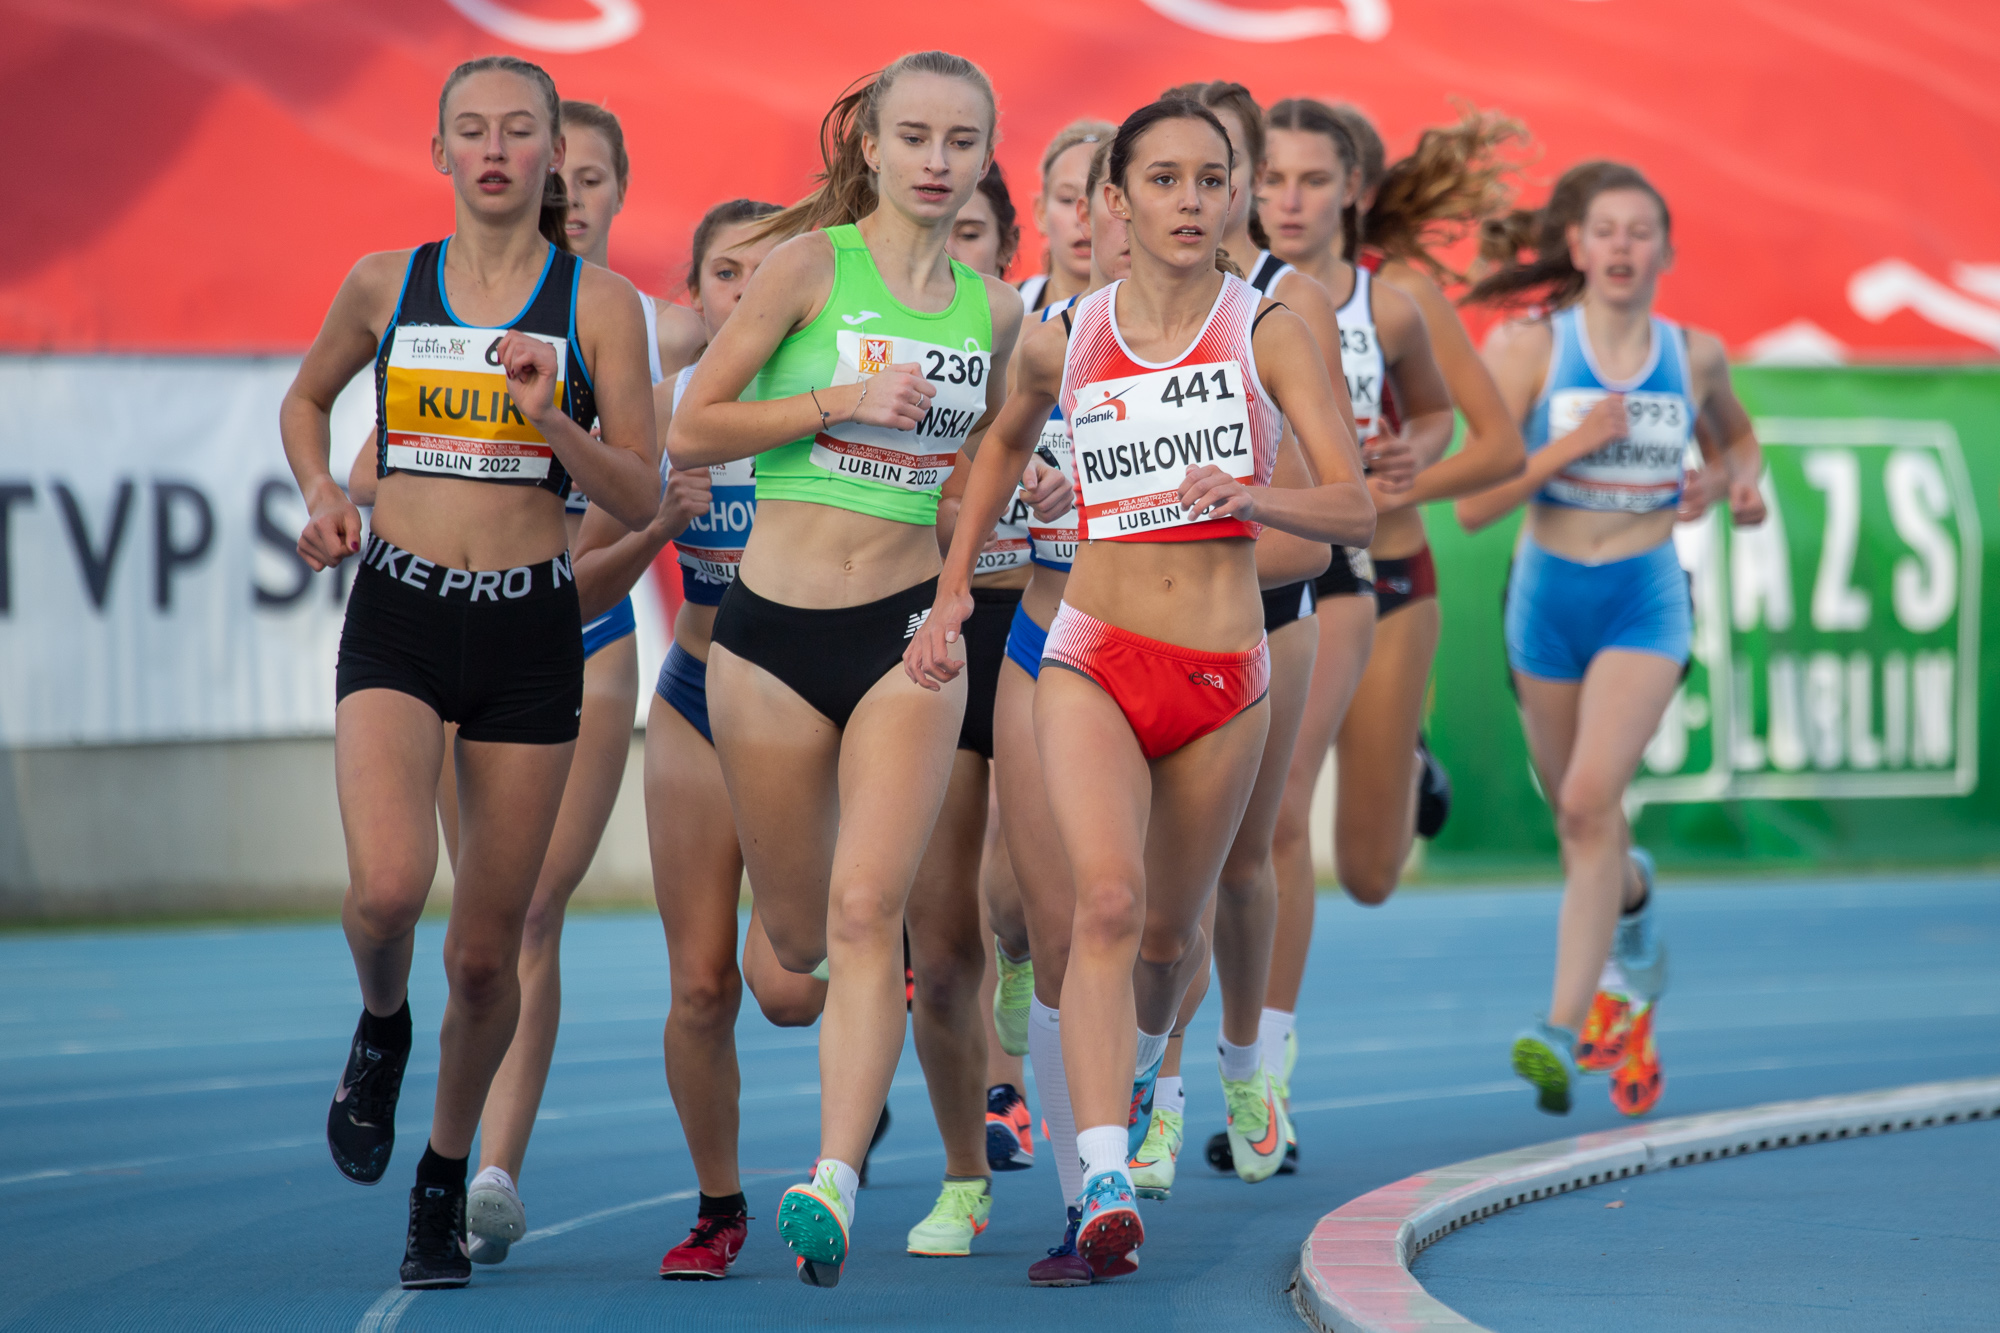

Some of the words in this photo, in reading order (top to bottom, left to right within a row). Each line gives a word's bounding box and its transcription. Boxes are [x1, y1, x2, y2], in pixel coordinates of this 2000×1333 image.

[926, 350, 983, 387] 230
[1161, 369, 1234, 408] 441
[419, 386, 525, 426] KULIK
[416, 450, 472, 470] LUBLIN
[478, 458, 521, 473] 2022
[1082, 423, 1248, 484] RUSIŁOWICZ
[838, 456, 902, 482] LUBLIN
[905, 469, 938, 486] 2022
[1118, 505, 1181, 530] LUBLIN
[976, 552, 1019, 568] 2022
[439, 566, 532, 602] PRO
[1189, 671, 1225, 689] esa
